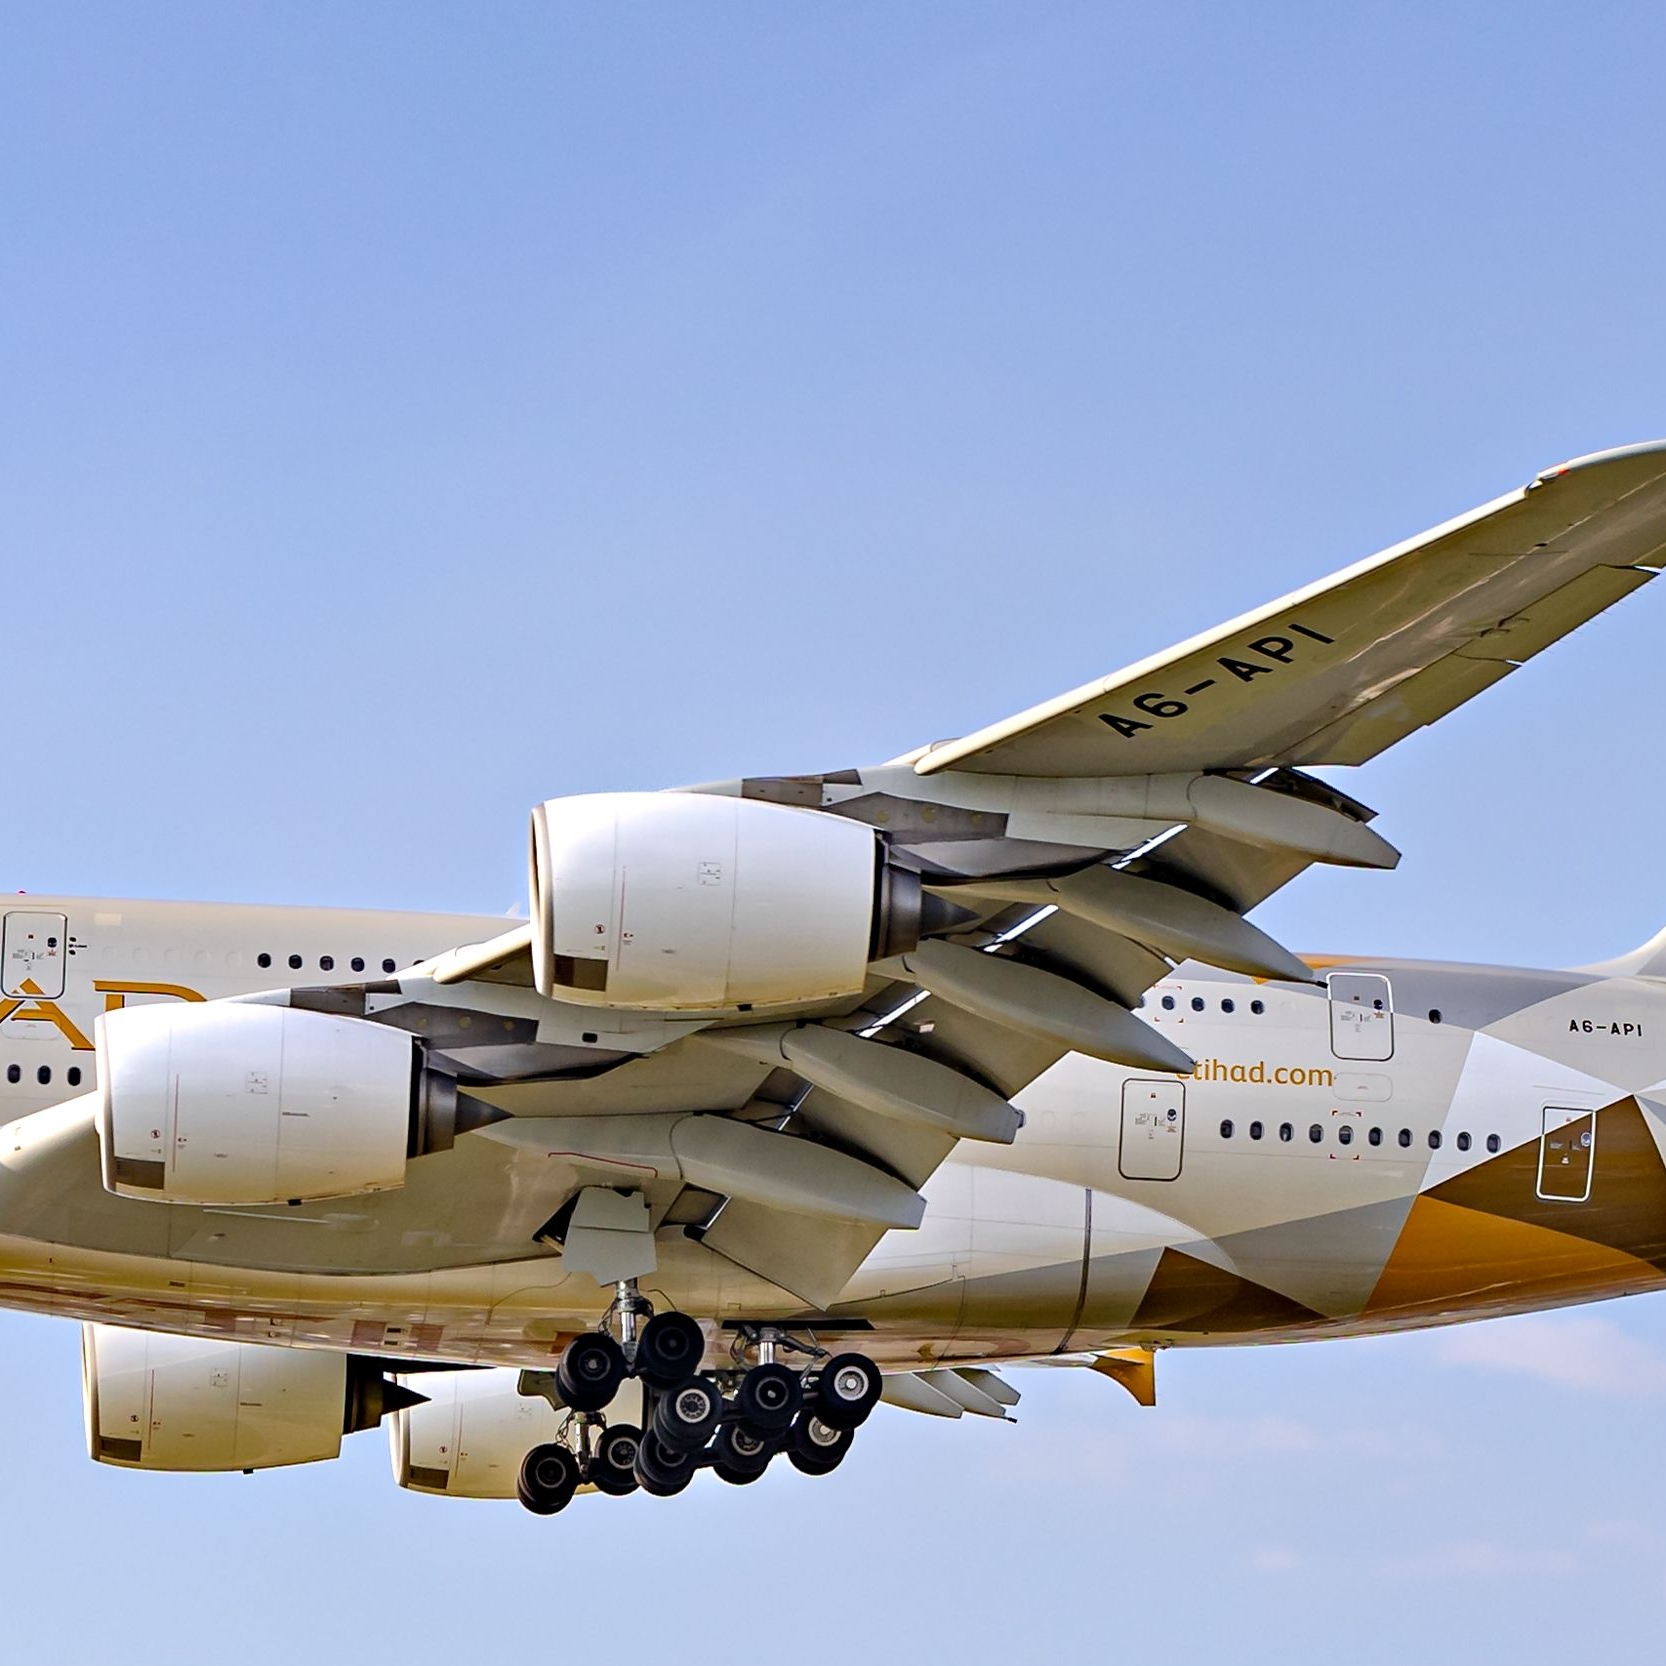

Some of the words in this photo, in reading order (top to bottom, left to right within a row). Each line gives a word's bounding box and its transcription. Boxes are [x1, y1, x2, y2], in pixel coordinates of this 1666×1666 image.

[1098, 623, 1335, 738] A6-API
[1569, 1019, 1642, 1037] A6-API
[1176, 1058, 1333, 1087] tihad.com
